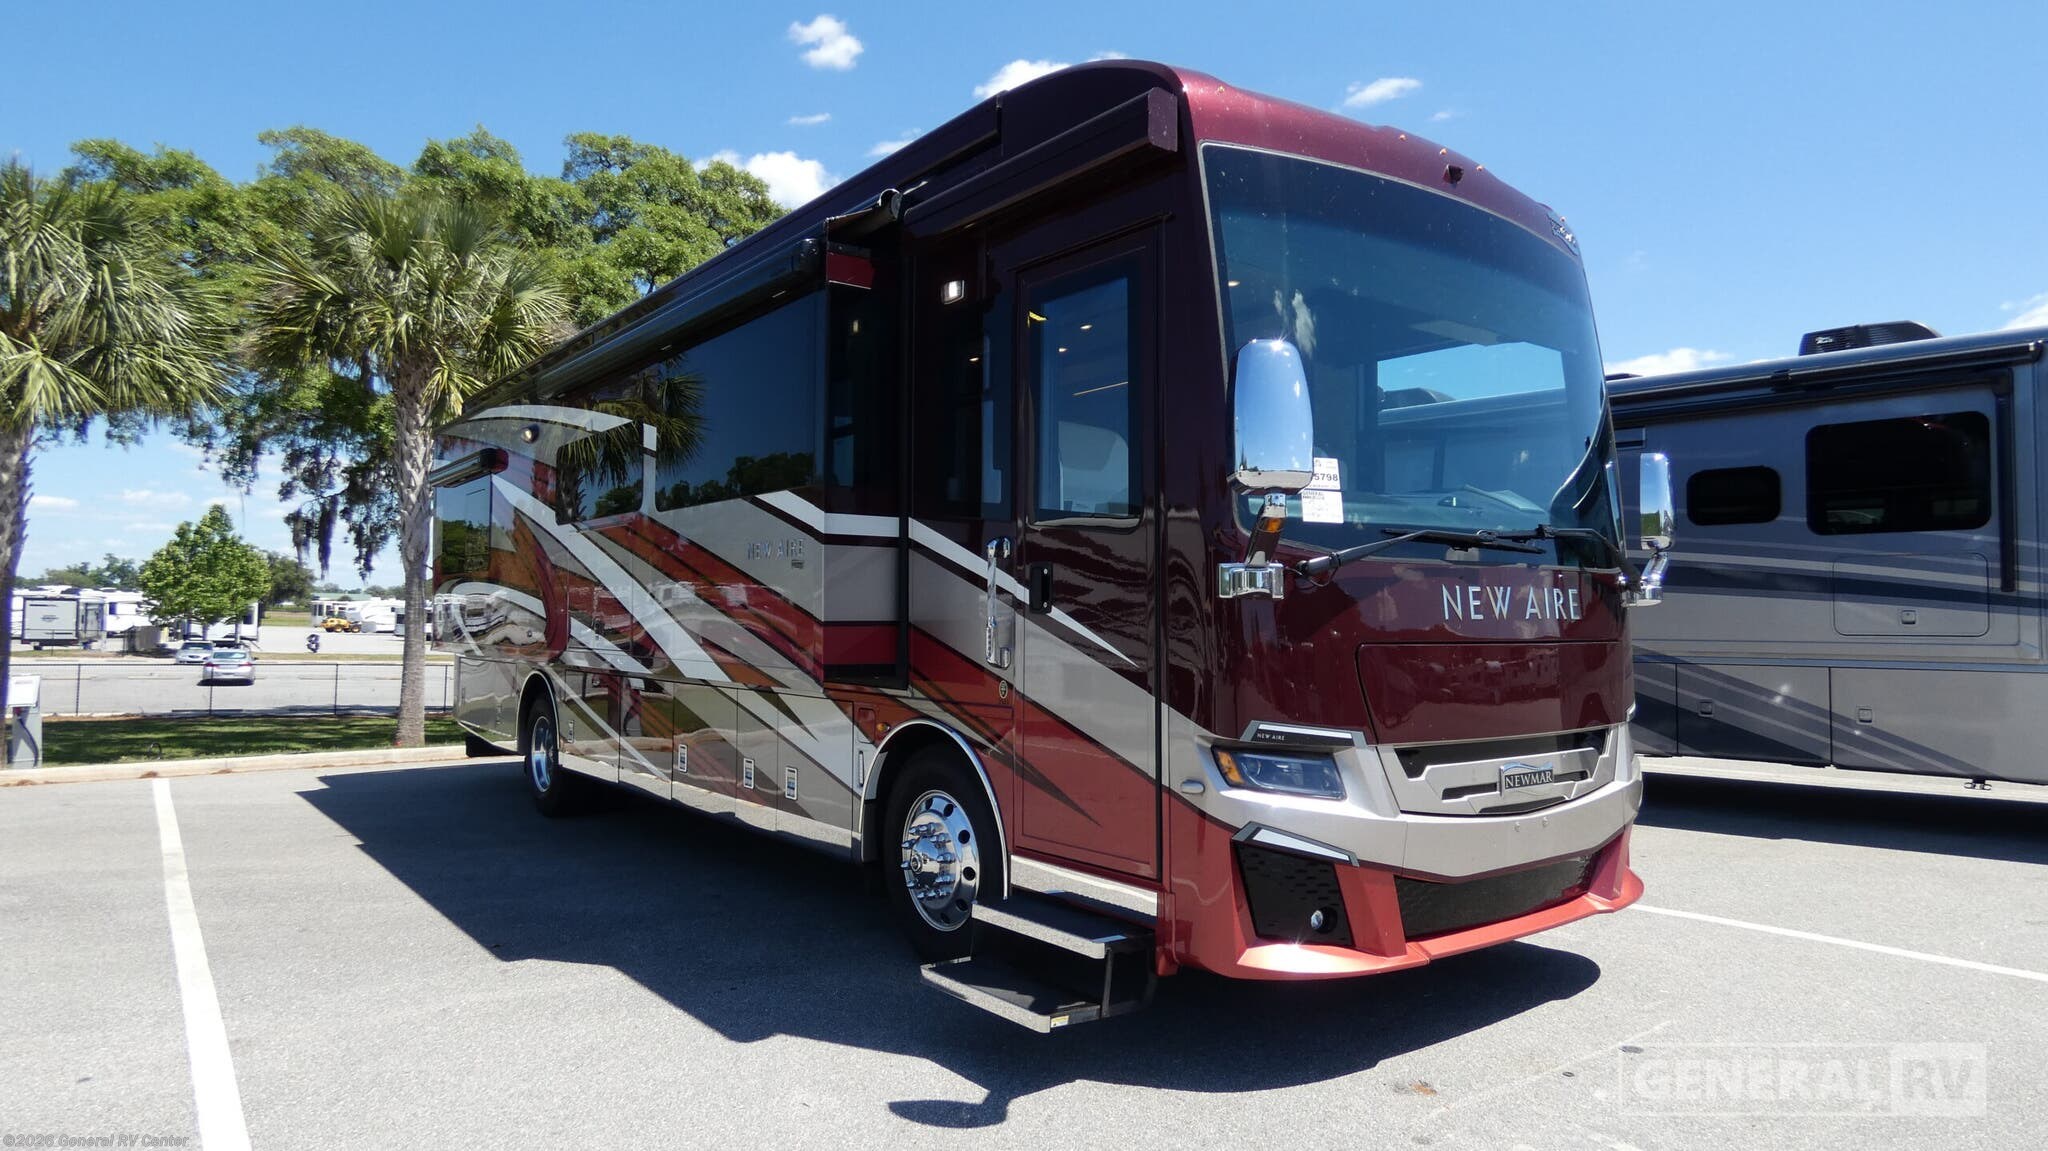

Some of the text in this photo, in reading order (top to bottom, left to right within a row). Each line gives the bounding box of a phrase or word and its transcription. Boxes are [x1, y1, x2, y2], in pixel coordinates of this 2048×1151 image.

[1312, 472, 1339, 481] 5798
[746, 539, 804, 560] NEW AIRE
[1442, 584, 1581, 620] NEW AIRE
[1505, 771, 1552, 788] NEWMAR
